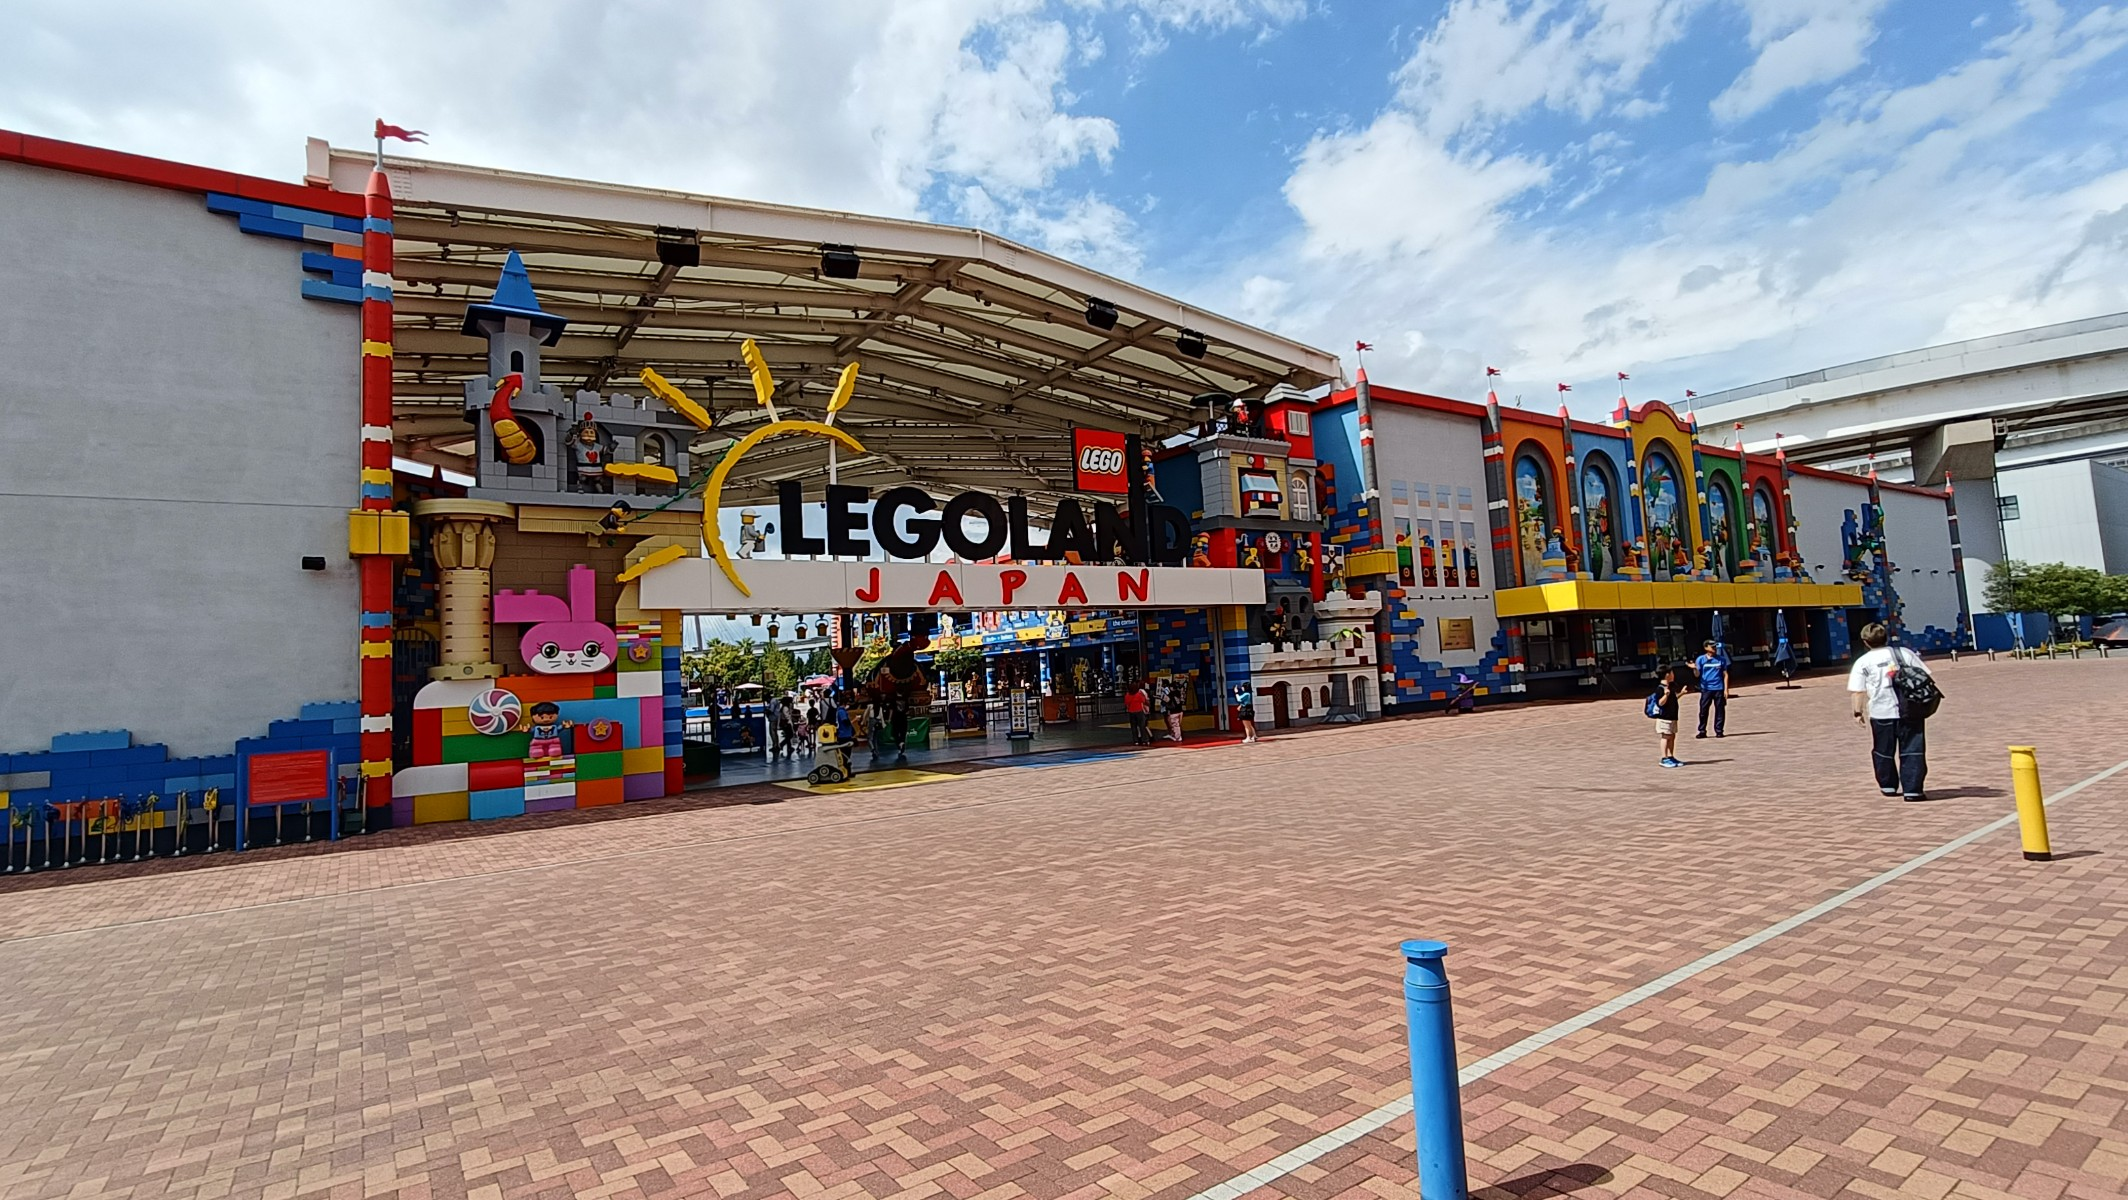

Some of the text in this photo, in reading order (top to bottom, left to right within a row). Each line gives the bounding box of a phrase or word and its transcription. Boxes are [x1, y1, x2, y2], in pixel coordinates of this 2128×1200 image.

[1080, 447, 1123, 473] LEGO
[779, 481, 1191, 567] LEGOLAND
[855, 567, 1150, 606] JAPAN
